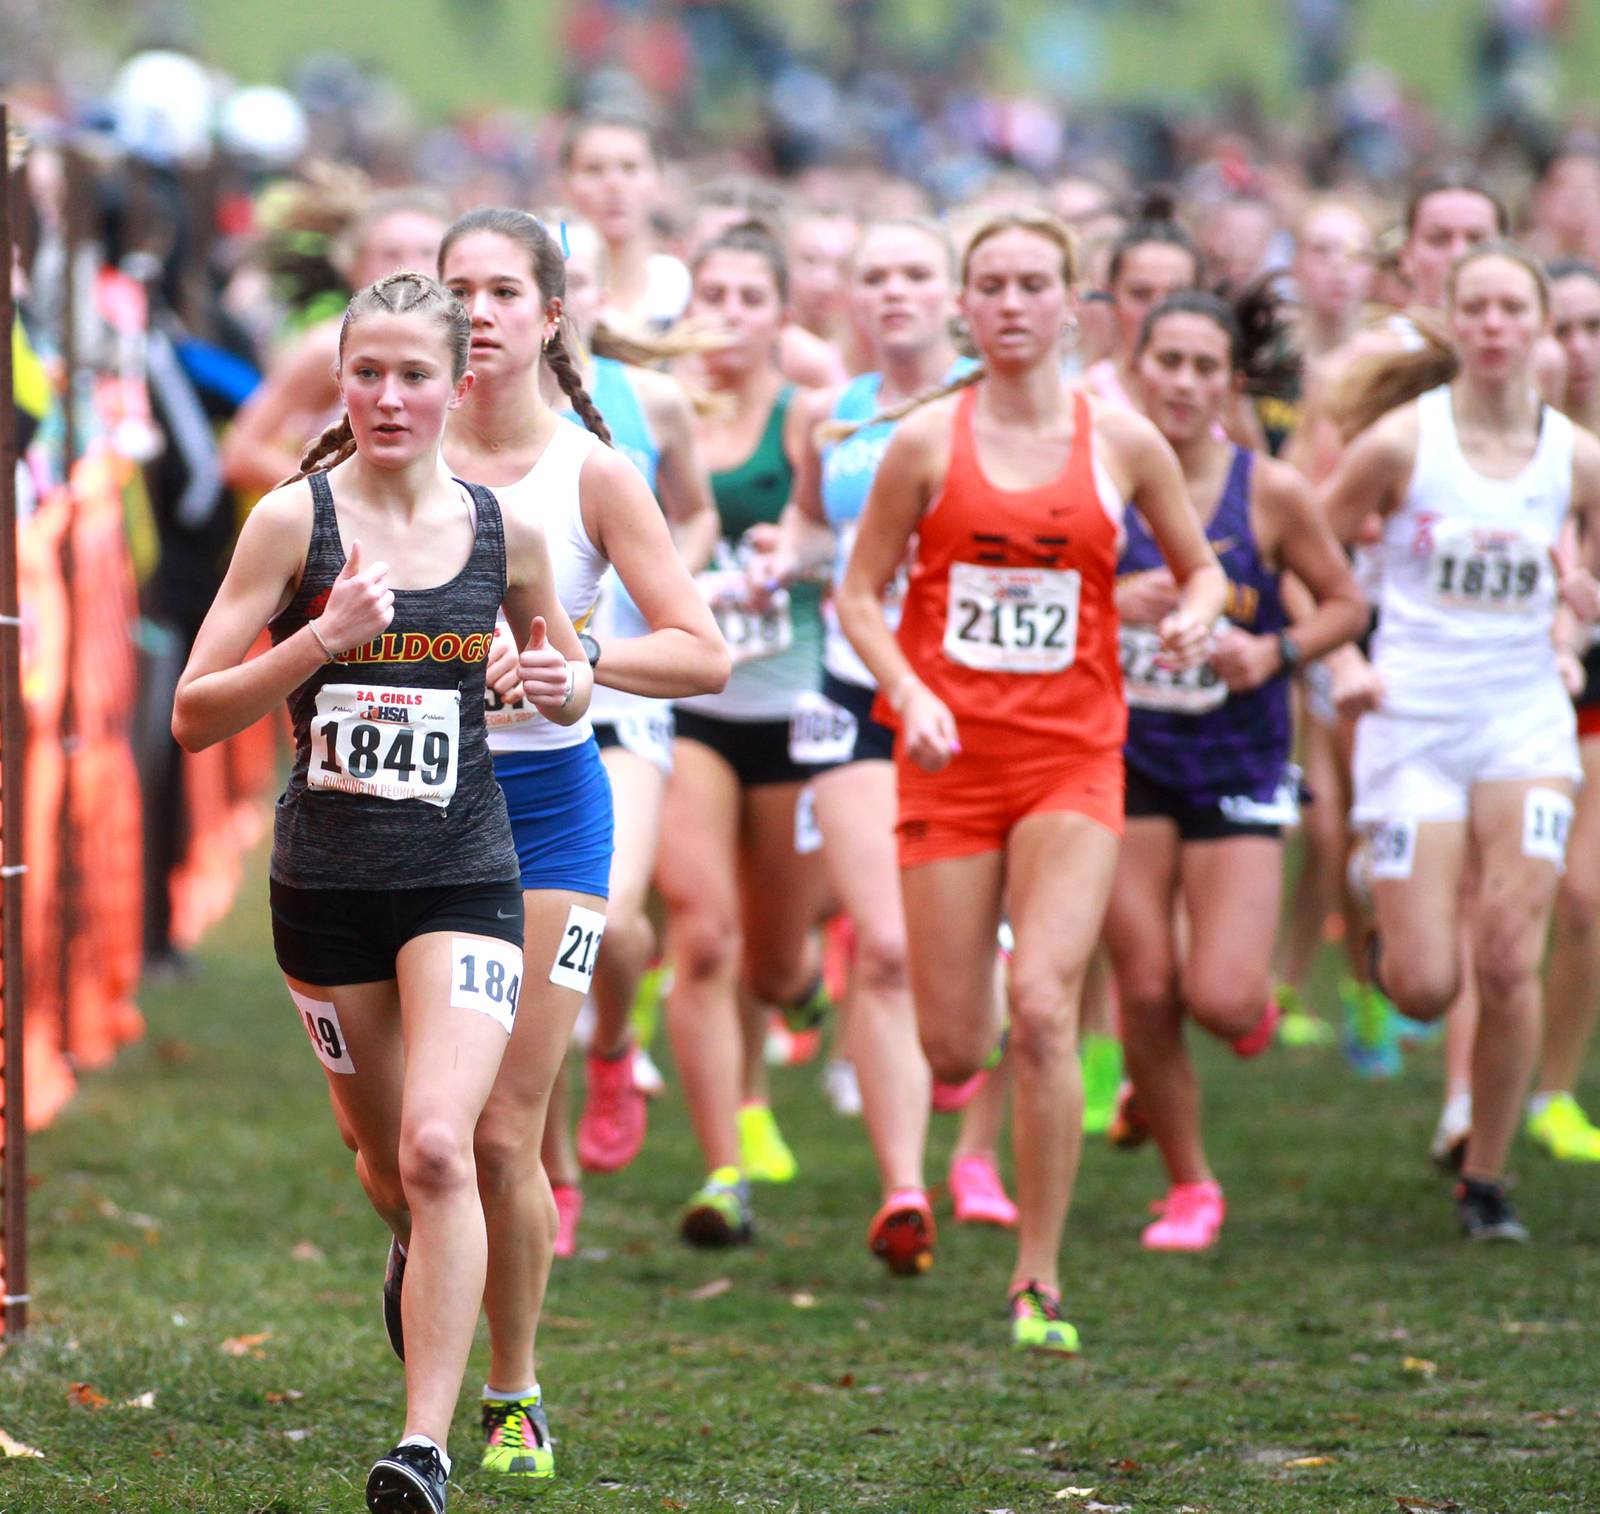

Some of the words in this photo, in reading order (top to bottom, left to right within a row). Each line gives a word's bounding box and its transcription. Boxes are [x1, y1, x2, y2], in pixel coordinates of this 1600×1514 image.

[1438, 556, 1539, 597] 1839
[958, 599, 1067, 649] 2152
[356, 691, 375, 702] 3A
[380, 693, 423, 705] GIRLS
[320, 720, 449, 786] 1849
[322, 775, 365, 793] RUNNING
[367, 783, 378, 796] IN
[380, 784, 415, 799] PEORIA
[458, 954, 519, 1016] 184
[305, 1010, 342, 1059] 49
